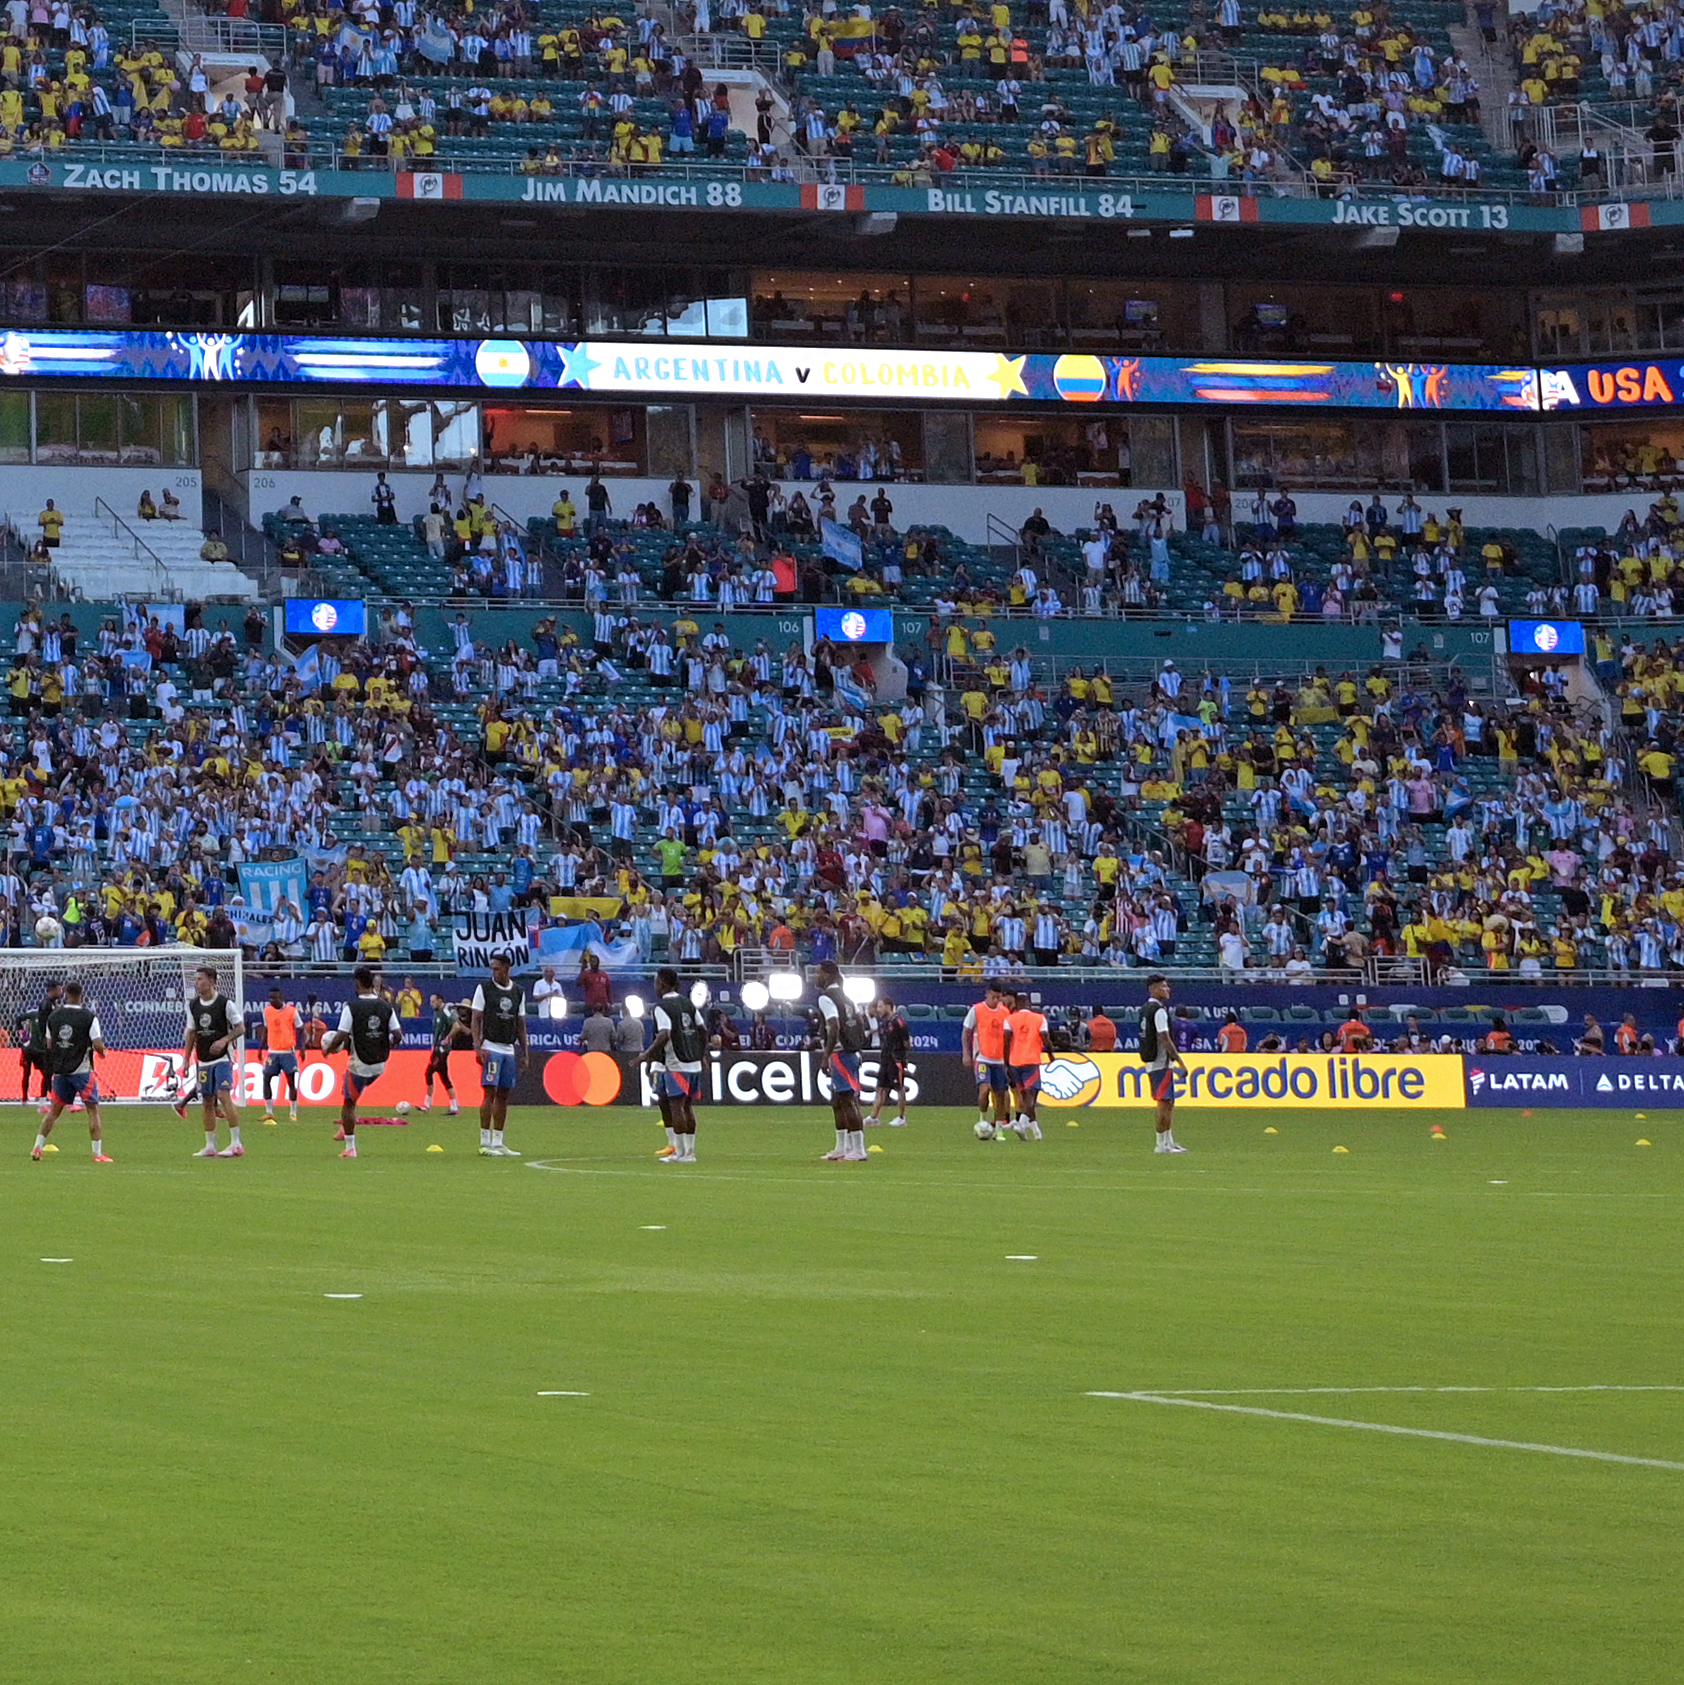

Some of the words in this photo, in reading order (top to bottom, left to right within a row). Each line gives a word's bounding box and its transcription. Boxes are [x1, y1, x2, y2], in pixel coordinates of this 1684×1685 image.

[64, 164, 145, 188] ZACH
[151, 167, 269, 192] THOMAS
[279, 170, 317, 195] 54
[522, 177, 567, 203] JIM
[576, 179, 697, 206] MANDICH
[706, 181, 742, 206] 88
[927, 188, 973, 213] BILL
[979, 190, 1088, 215] STANFILL
[1098, 193, 1133, 216] 84
[1332, 201, 1388, 225] JAKE
[1396, 202, 1471, 227] SCOTT
[1482, 204, 1508, 229] 13
[613, 357, 783, 385] ARGENTINA
[823, 361, 970, 389] COLOMBIA
[1587, 366, 1673, 404] USA
[175, 476, 197, 488] 205
[254, 477, 276, 489] 206
[779, 621, 799, 634] 106
[902, 622, 922, 634] 107
[1470, 632, 1489, 644] 107
[242, 863, 302, 878] RACING
[456, 911, 526, 942] JUAN
[908, 1035, 939, 1049] 2024
[1118, 1056, 1316, 1099] mercado
[1328, 1057, 1425, 1099] libre
[1489, 1073, 1569, 1090] LATAM
